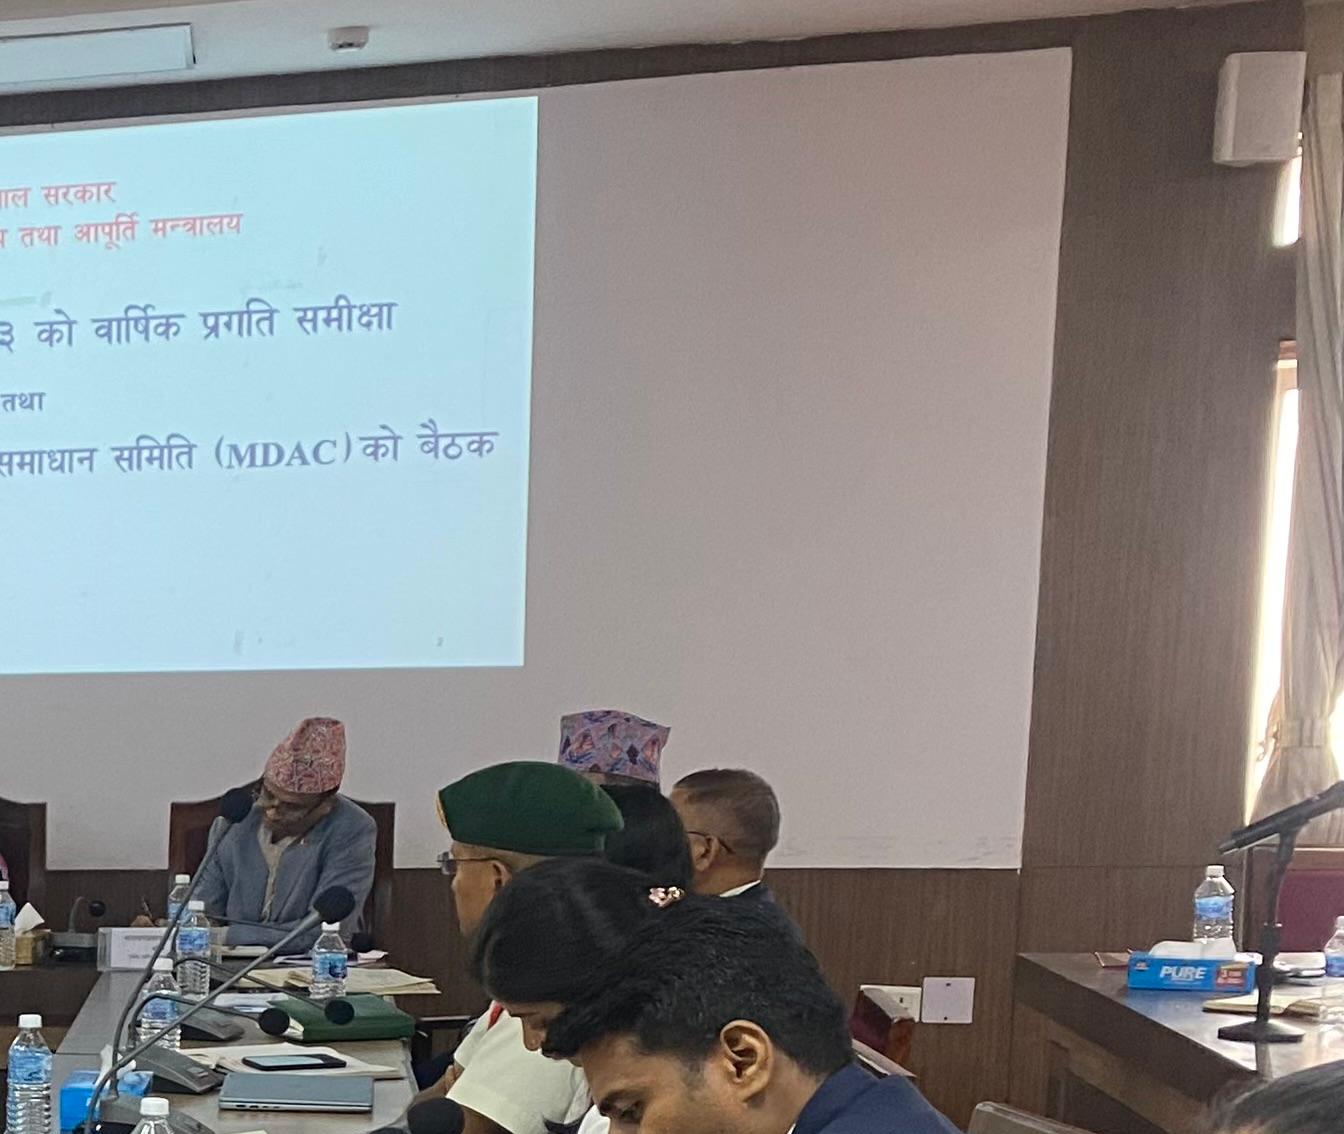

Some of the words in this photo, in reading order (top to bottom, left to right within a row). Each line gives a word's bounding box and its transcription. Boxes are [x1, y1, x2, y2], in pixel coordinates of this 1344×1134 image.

[41, 182, 116, 205] सरकार
[19, 226, 61, 247] तथा
[75, 212, 139, 250] आपूर्ति
[149, 214, 243, 238] मन्त्रालय
[34, 309, 78, 347] को
[91, 304, 186, 344] वार्षिक
[199, 298, 280, 340] प्रगति
[293, 294, 398, 335] समीक्षा
[0, 392, 46, 411] तथा
[110, 433, 197, 472] समिति
[215, 432, 351, 469] (MDAC)
[359, 424, 403, 462] को
[416, 419, 499, 460] बैठक
[1160, 966, 1206, 978] PURE
